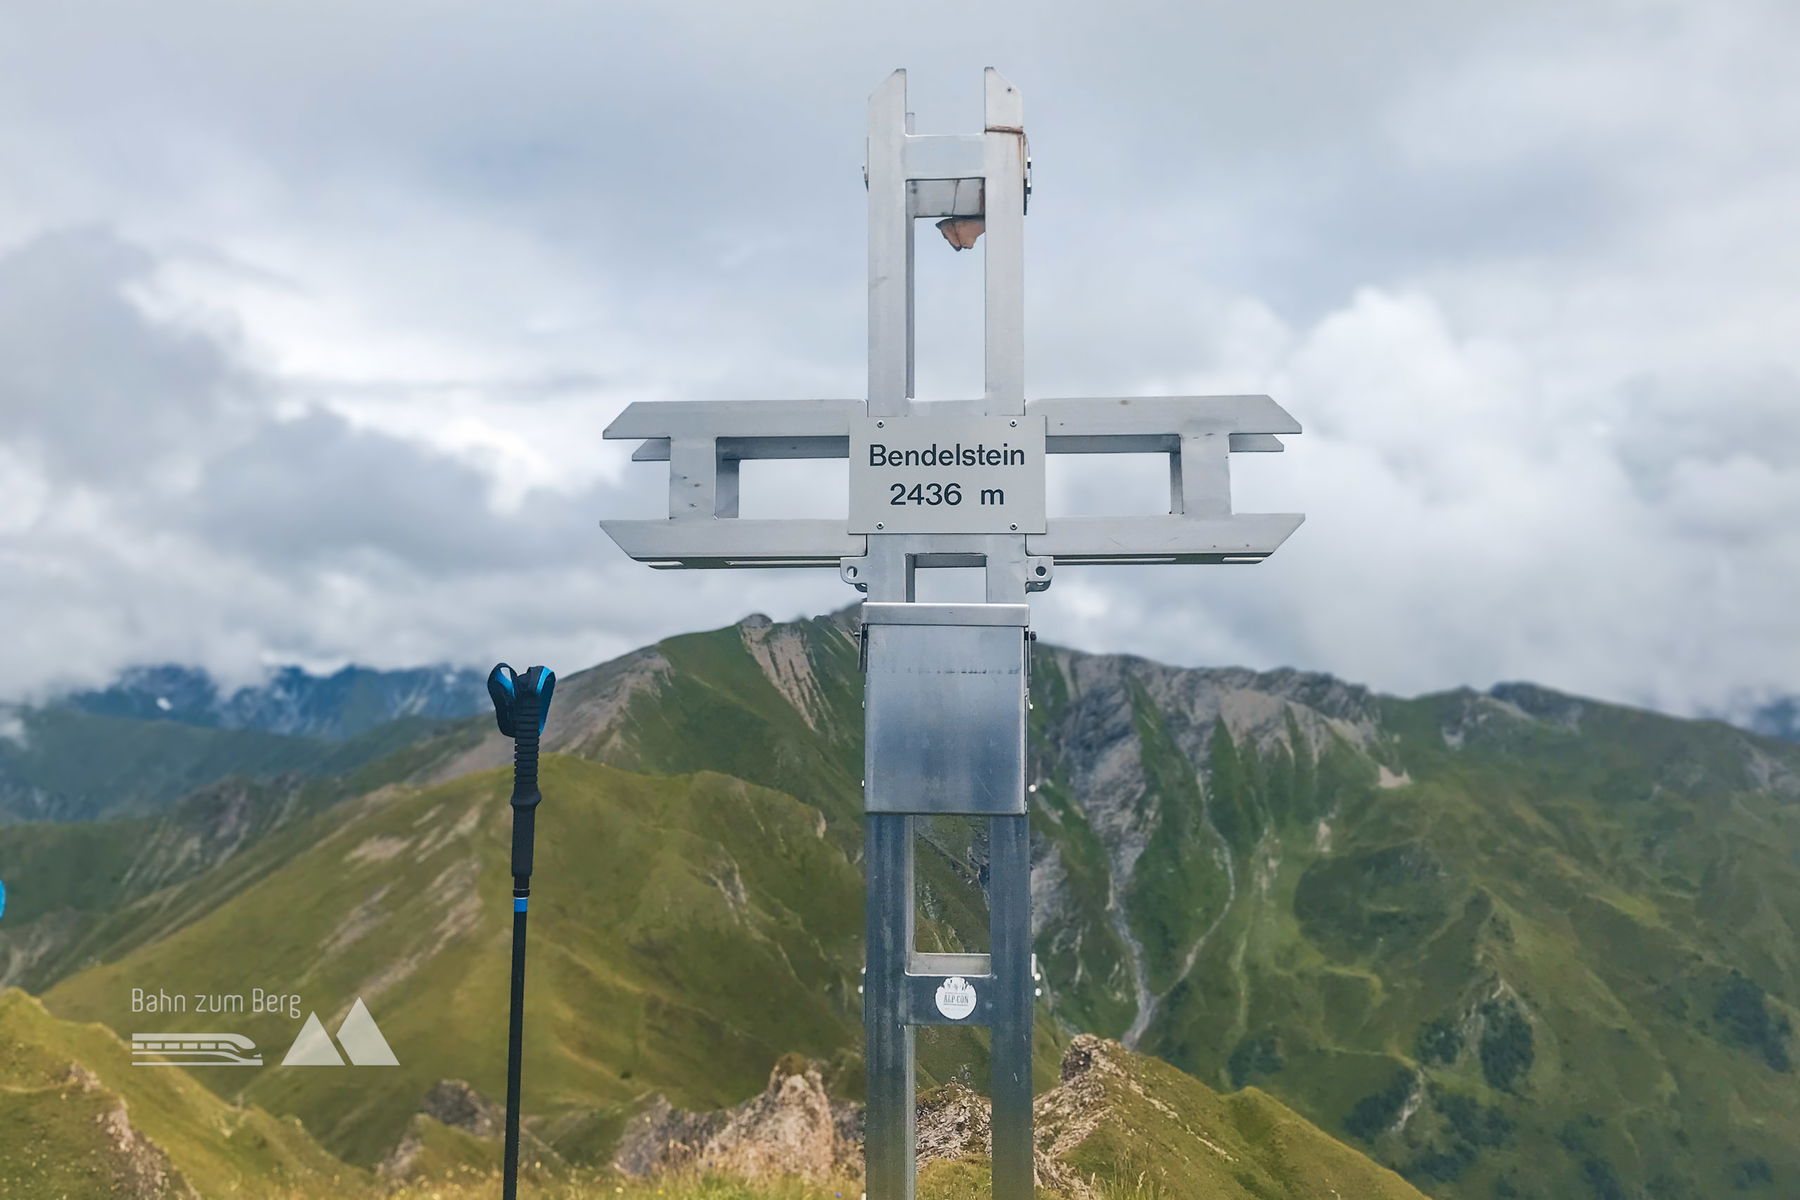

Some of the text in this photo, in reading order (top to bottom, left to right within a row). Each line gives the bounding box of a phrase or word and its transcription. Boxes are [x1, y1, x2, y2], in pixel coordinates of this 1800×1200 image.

[869, 443, 1025, 467] Bendelstein
[890, 482, 1005, 506] 2436 m
